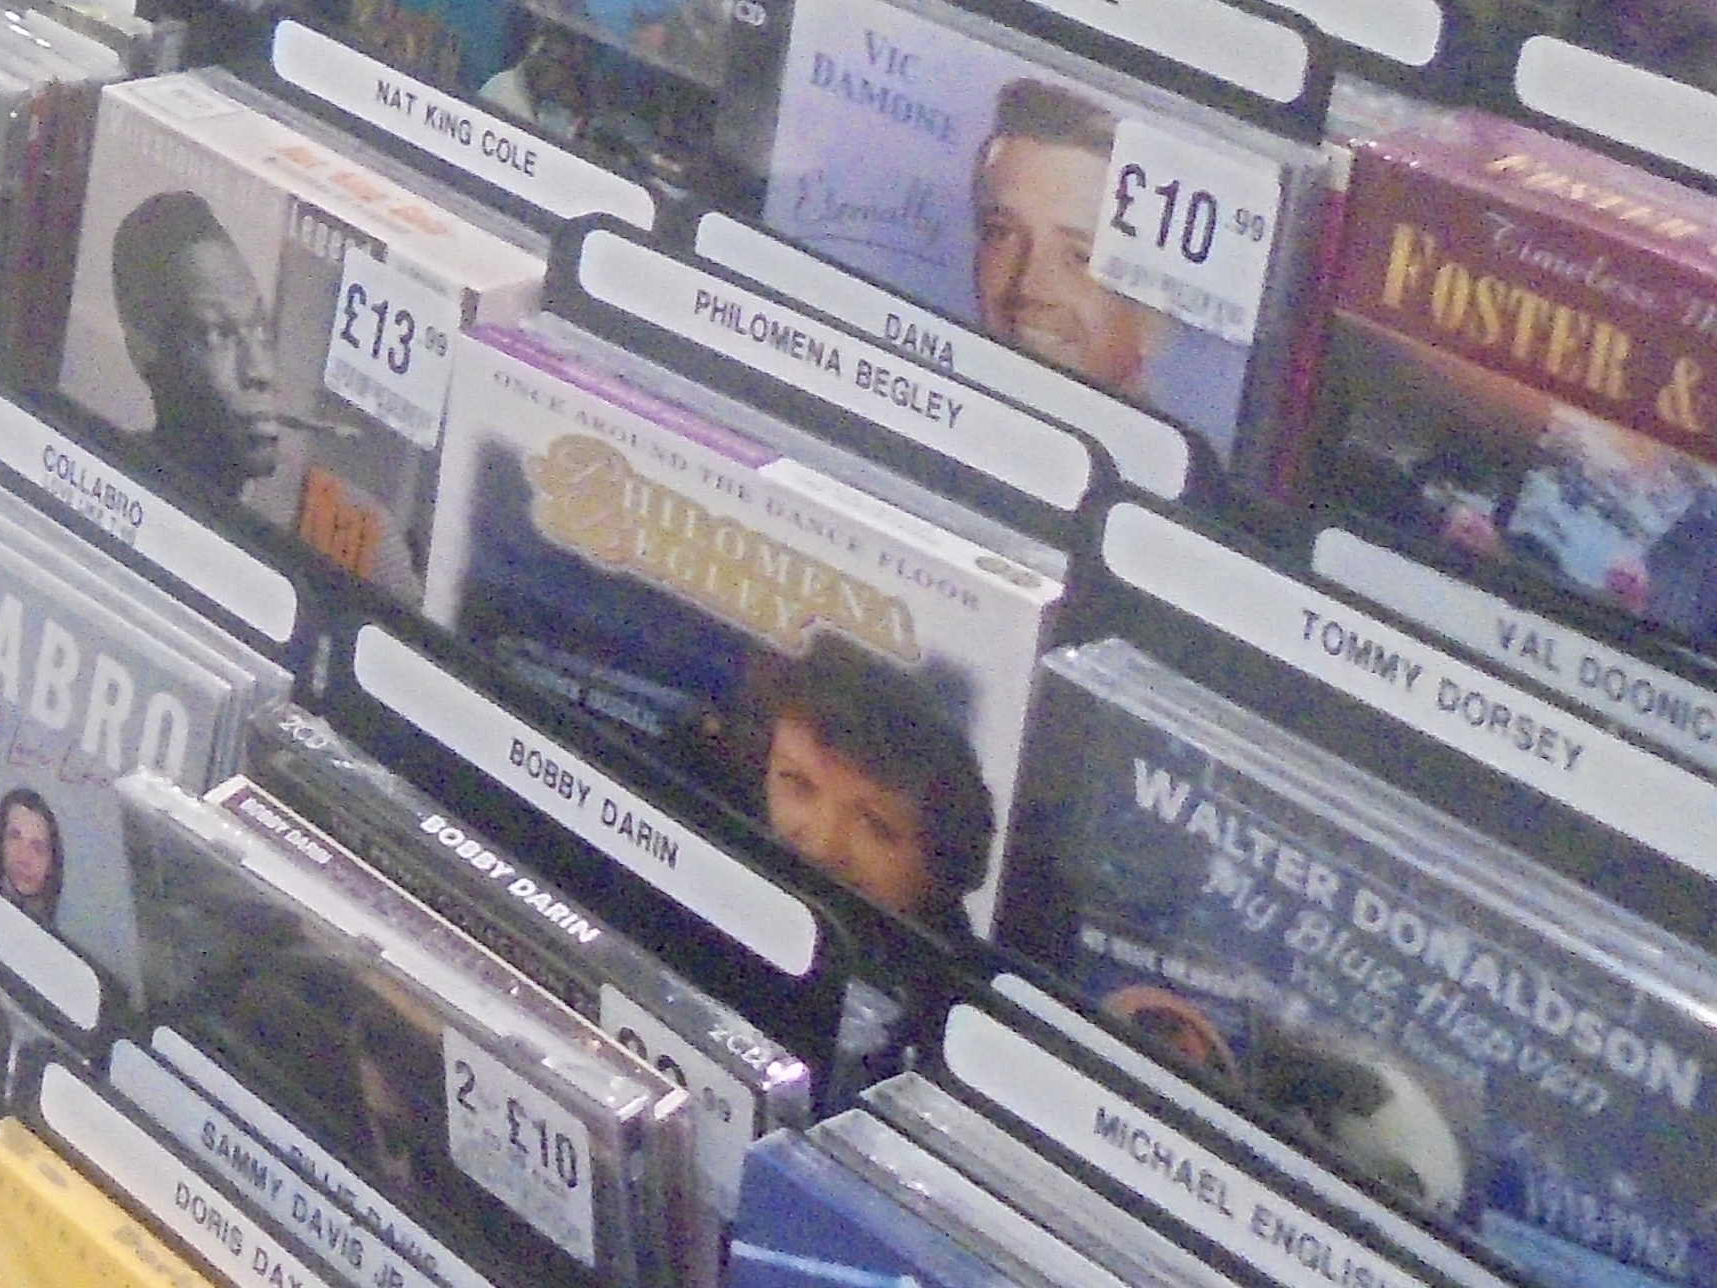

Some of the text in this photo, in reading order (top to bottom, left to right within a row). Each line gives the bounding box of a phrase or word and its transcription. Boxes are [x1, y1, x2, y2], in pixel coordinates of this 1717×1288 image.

[375, 78, 538, 178] NAT KING COLE
[694, 288, 965, 430] PHILOMENA BEGLEY
[884, 312, 957, 372] DANA
[43, 445, 144, 530] COLLABRO
[1302, 606, 1586, 773] TOMMY DORSEY
[508, 738, 681, 870] BOBBY DARIN
[420, 814, 601, 945] BOBBY DARIN
[1133, 758, 1344, 908] WALTER
[1354, 886, 1702, 1109] DONALDSON
